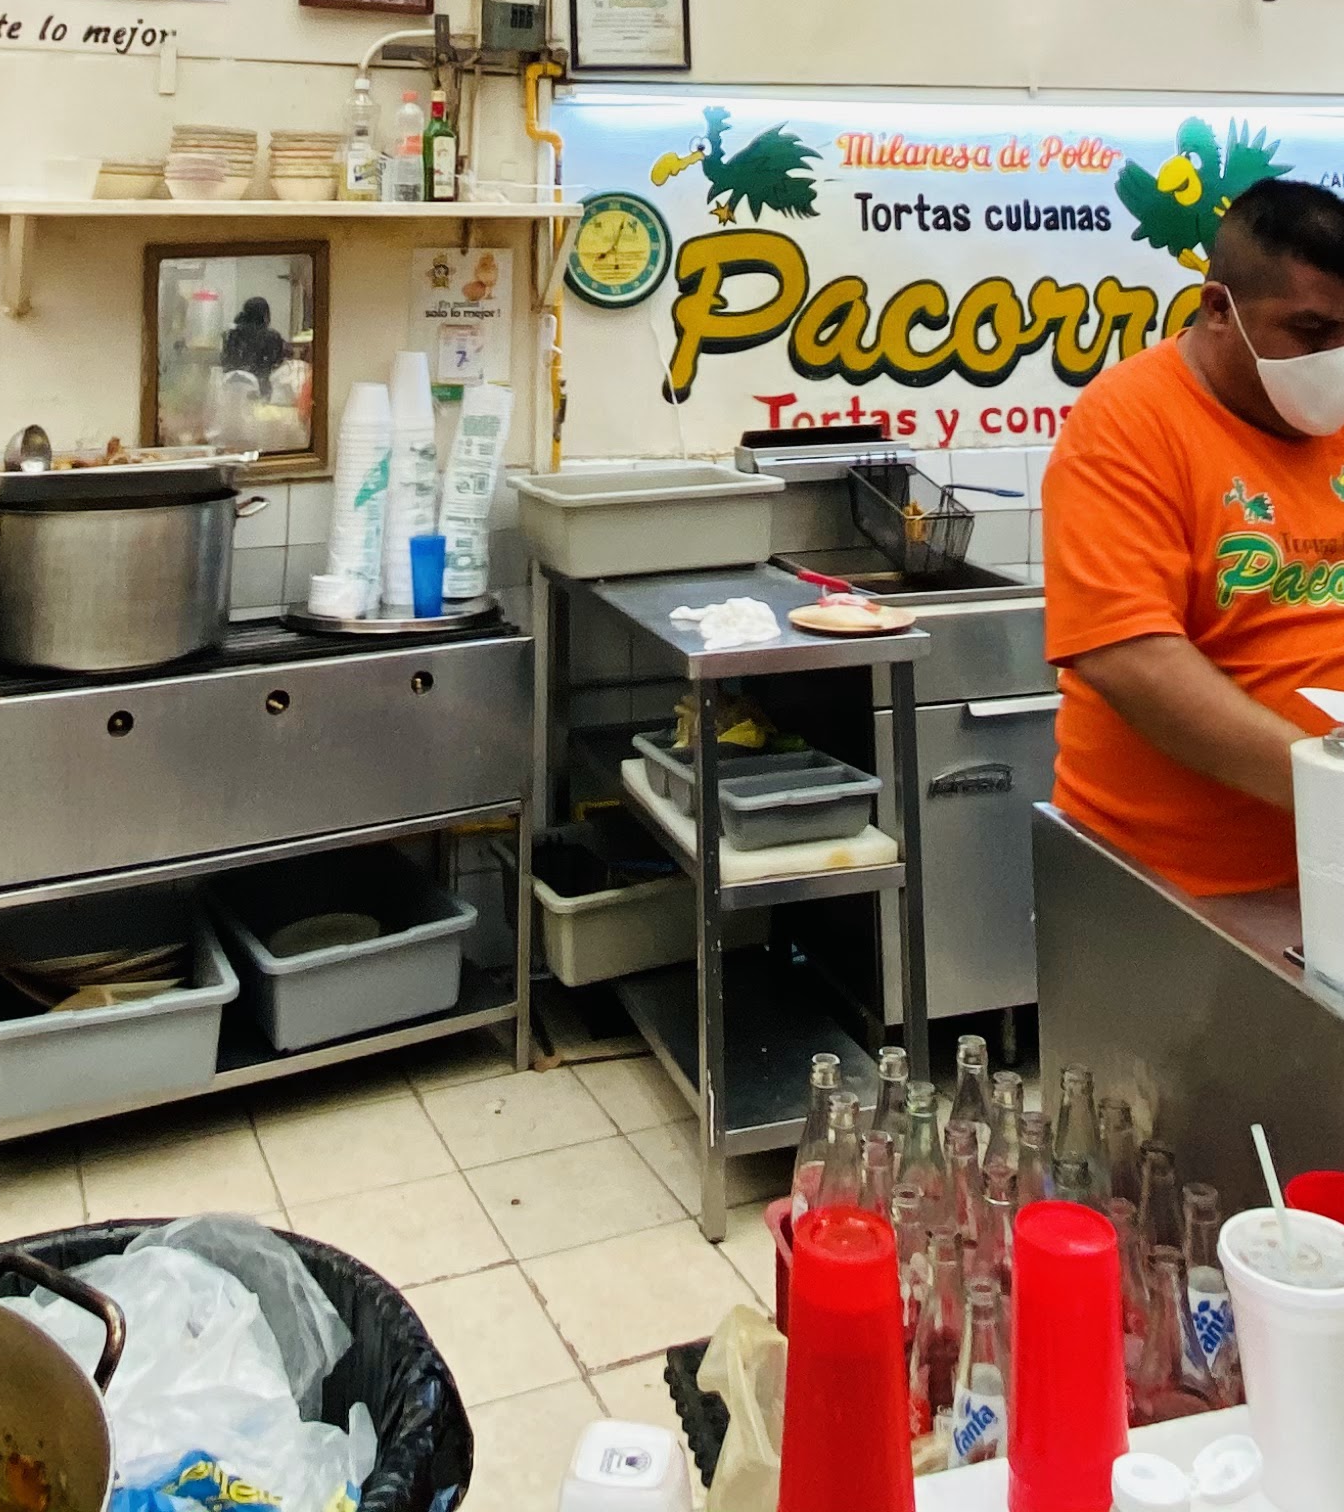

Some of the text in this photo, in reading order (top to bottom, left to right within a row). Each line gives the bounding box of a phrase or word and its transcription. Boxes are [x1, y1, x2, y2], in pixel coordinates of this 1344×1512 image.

[39, 14, 68, 43] lo
[82, 18, 177, 55] mejor
[836, 132, 1121, 174] Milanesa de Pollo
[853, 192, 1112, 232] Tortas cubanas
[456, 350, 470, 367] 7
[936, 407, 960, 449] y
